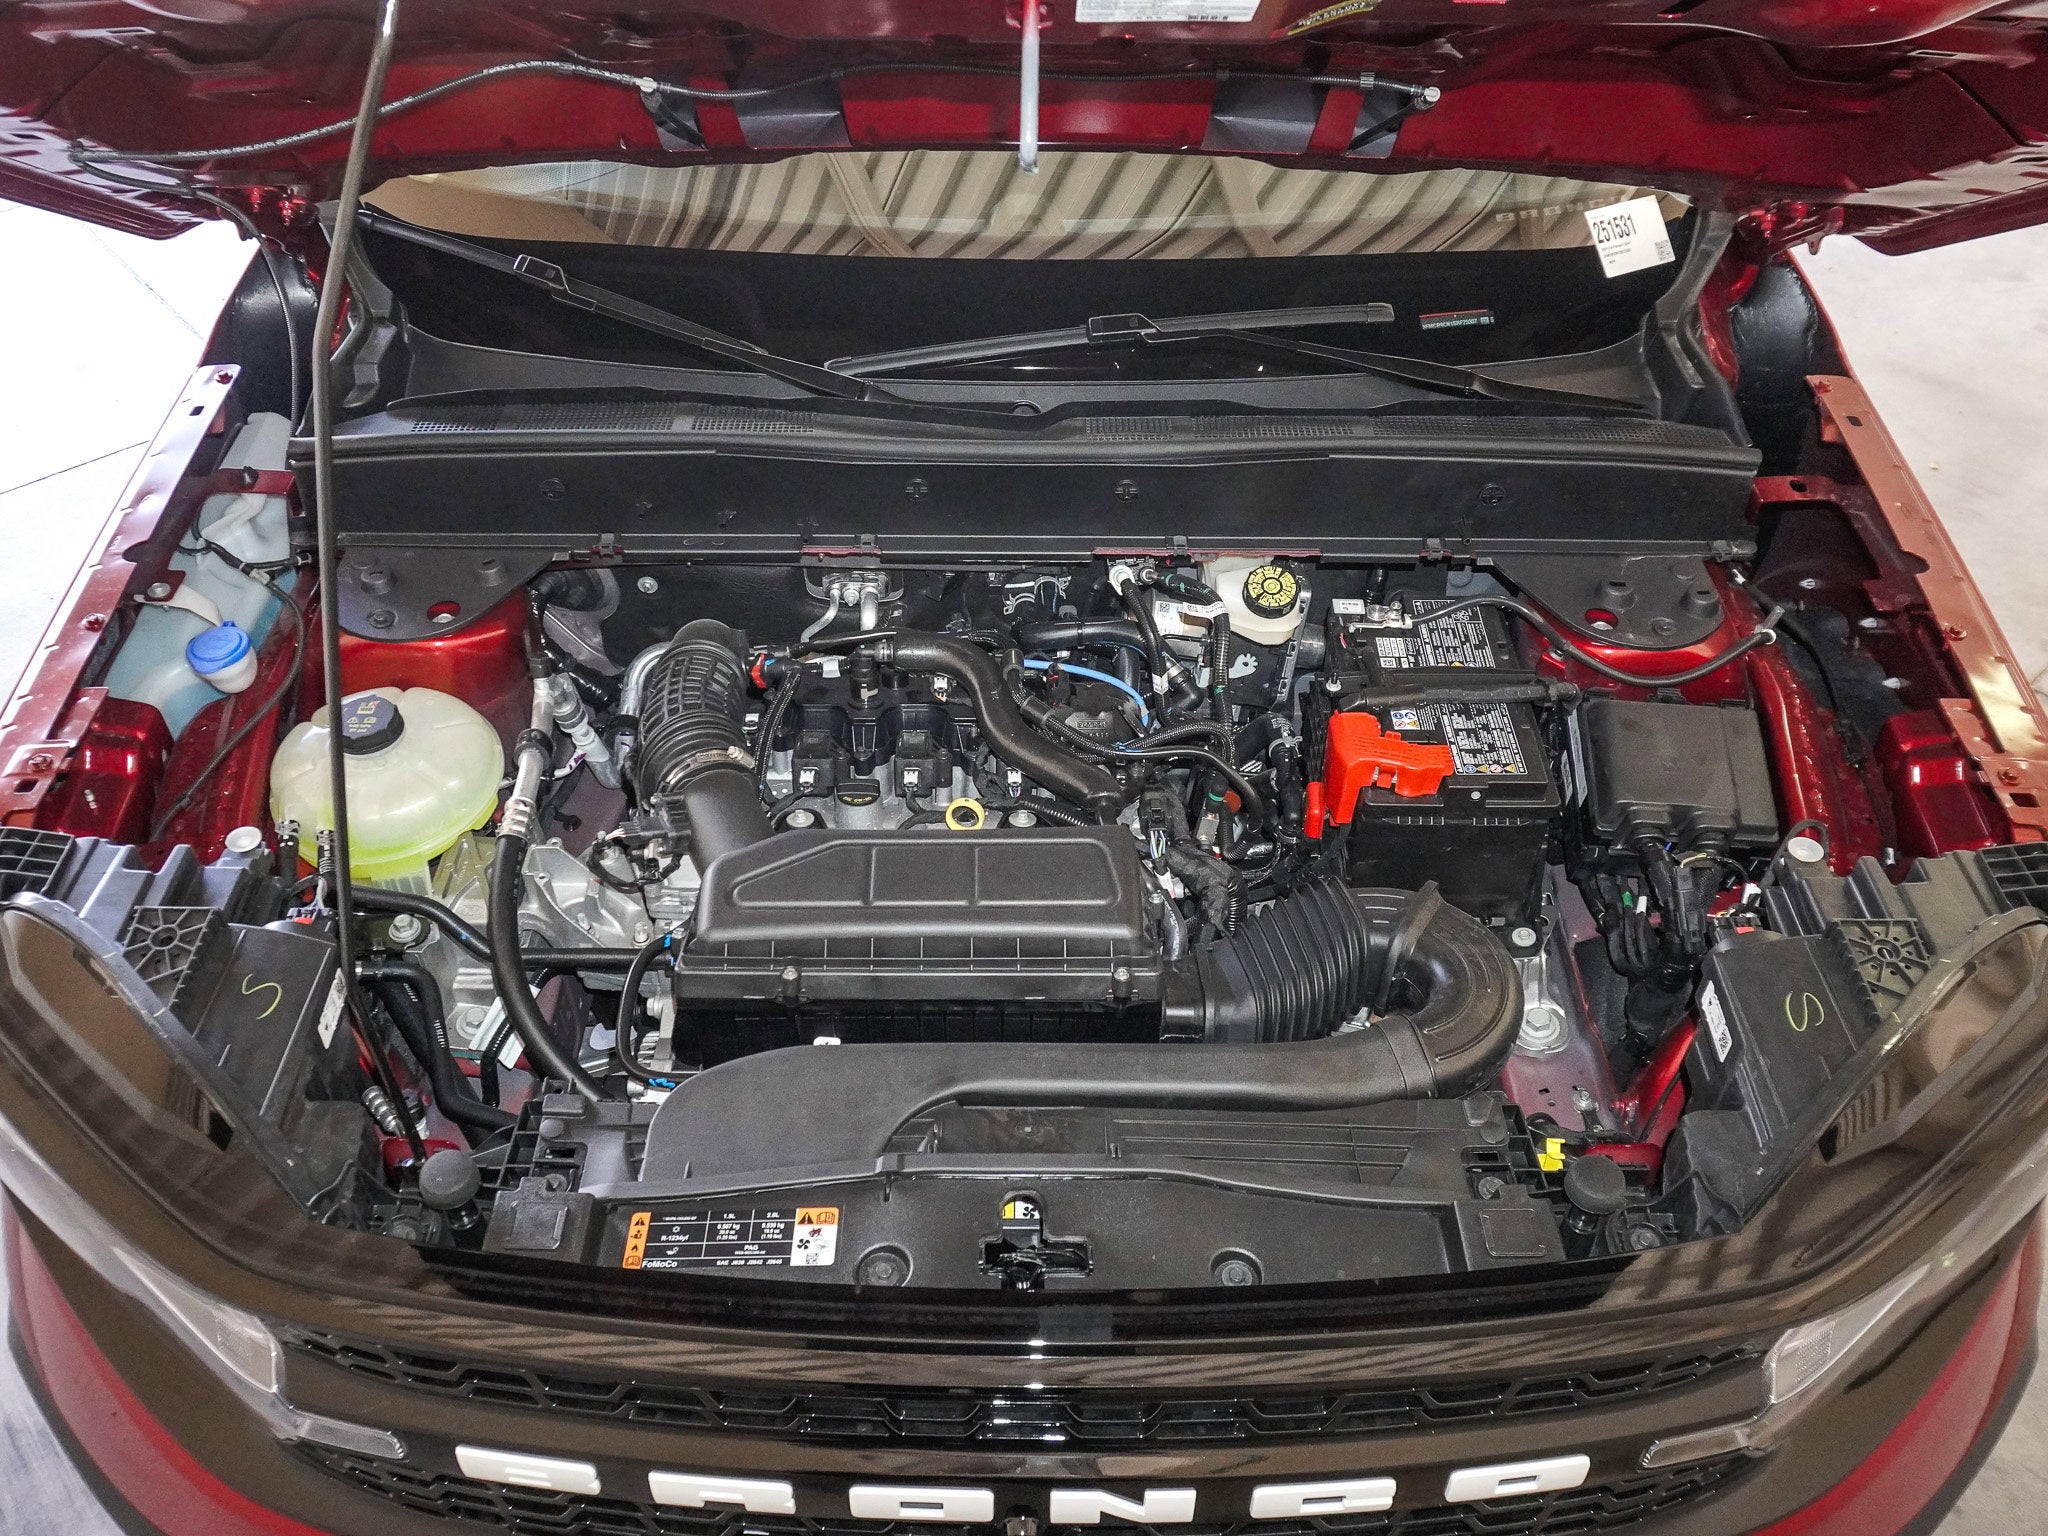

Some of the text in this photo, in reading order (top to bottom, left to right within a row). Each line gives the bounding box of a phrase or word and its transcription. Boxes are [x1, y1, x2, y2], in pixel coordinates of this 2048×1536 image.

[1593, 213, 1637, 244] 251531
[661, 1234, 690, 1242] R-1234yf
[641, 1260, 678, 1268] FoMoCo
[454, 1444, 1591, 1525] BRONCO
